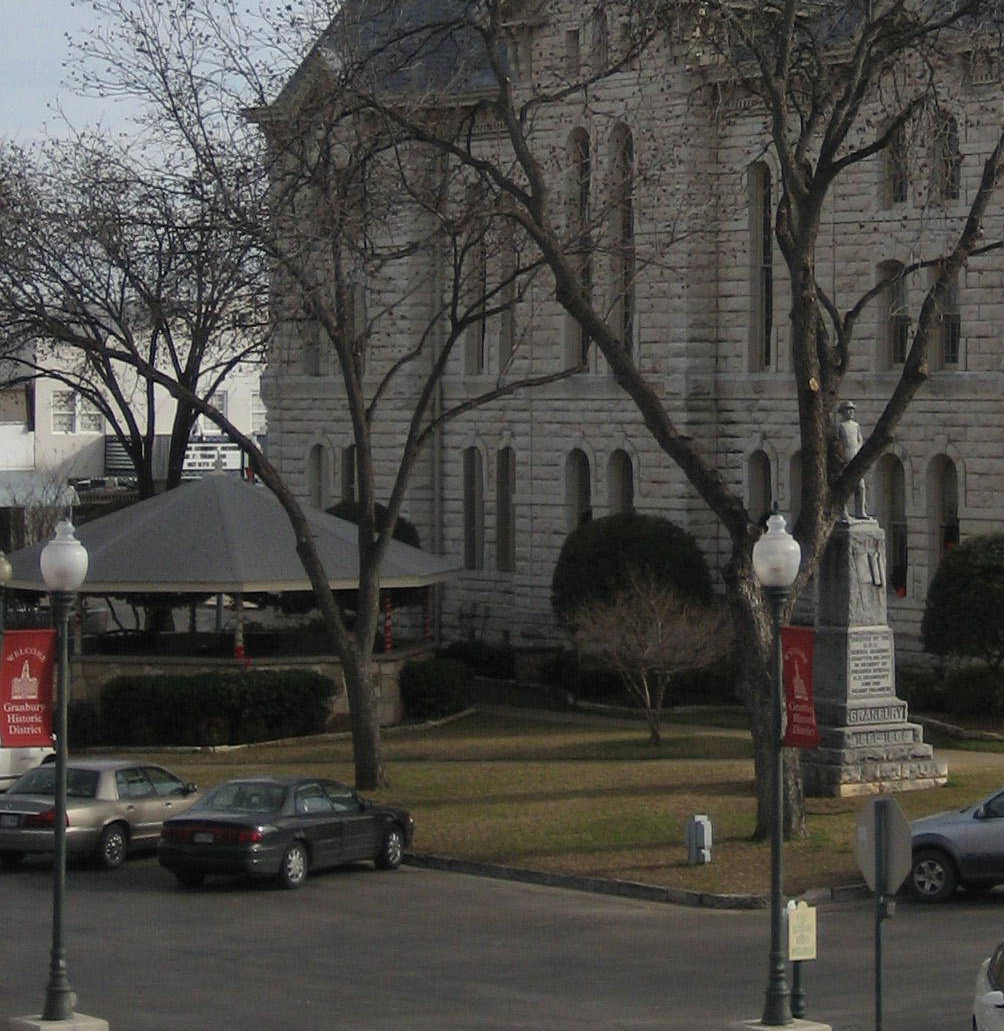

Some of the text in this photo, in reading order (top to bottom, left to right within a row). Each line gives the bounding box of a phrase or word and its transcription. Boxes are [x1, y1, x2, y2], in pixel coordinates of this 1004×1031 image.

[6, 648, 47, 663] WELCOME
[3, 702, 45, 713] Granbury
[7, 713, 42, 724] Historic
[850, 707, 905, 722] GRANBURY
[9, 725, 42, 735] District
